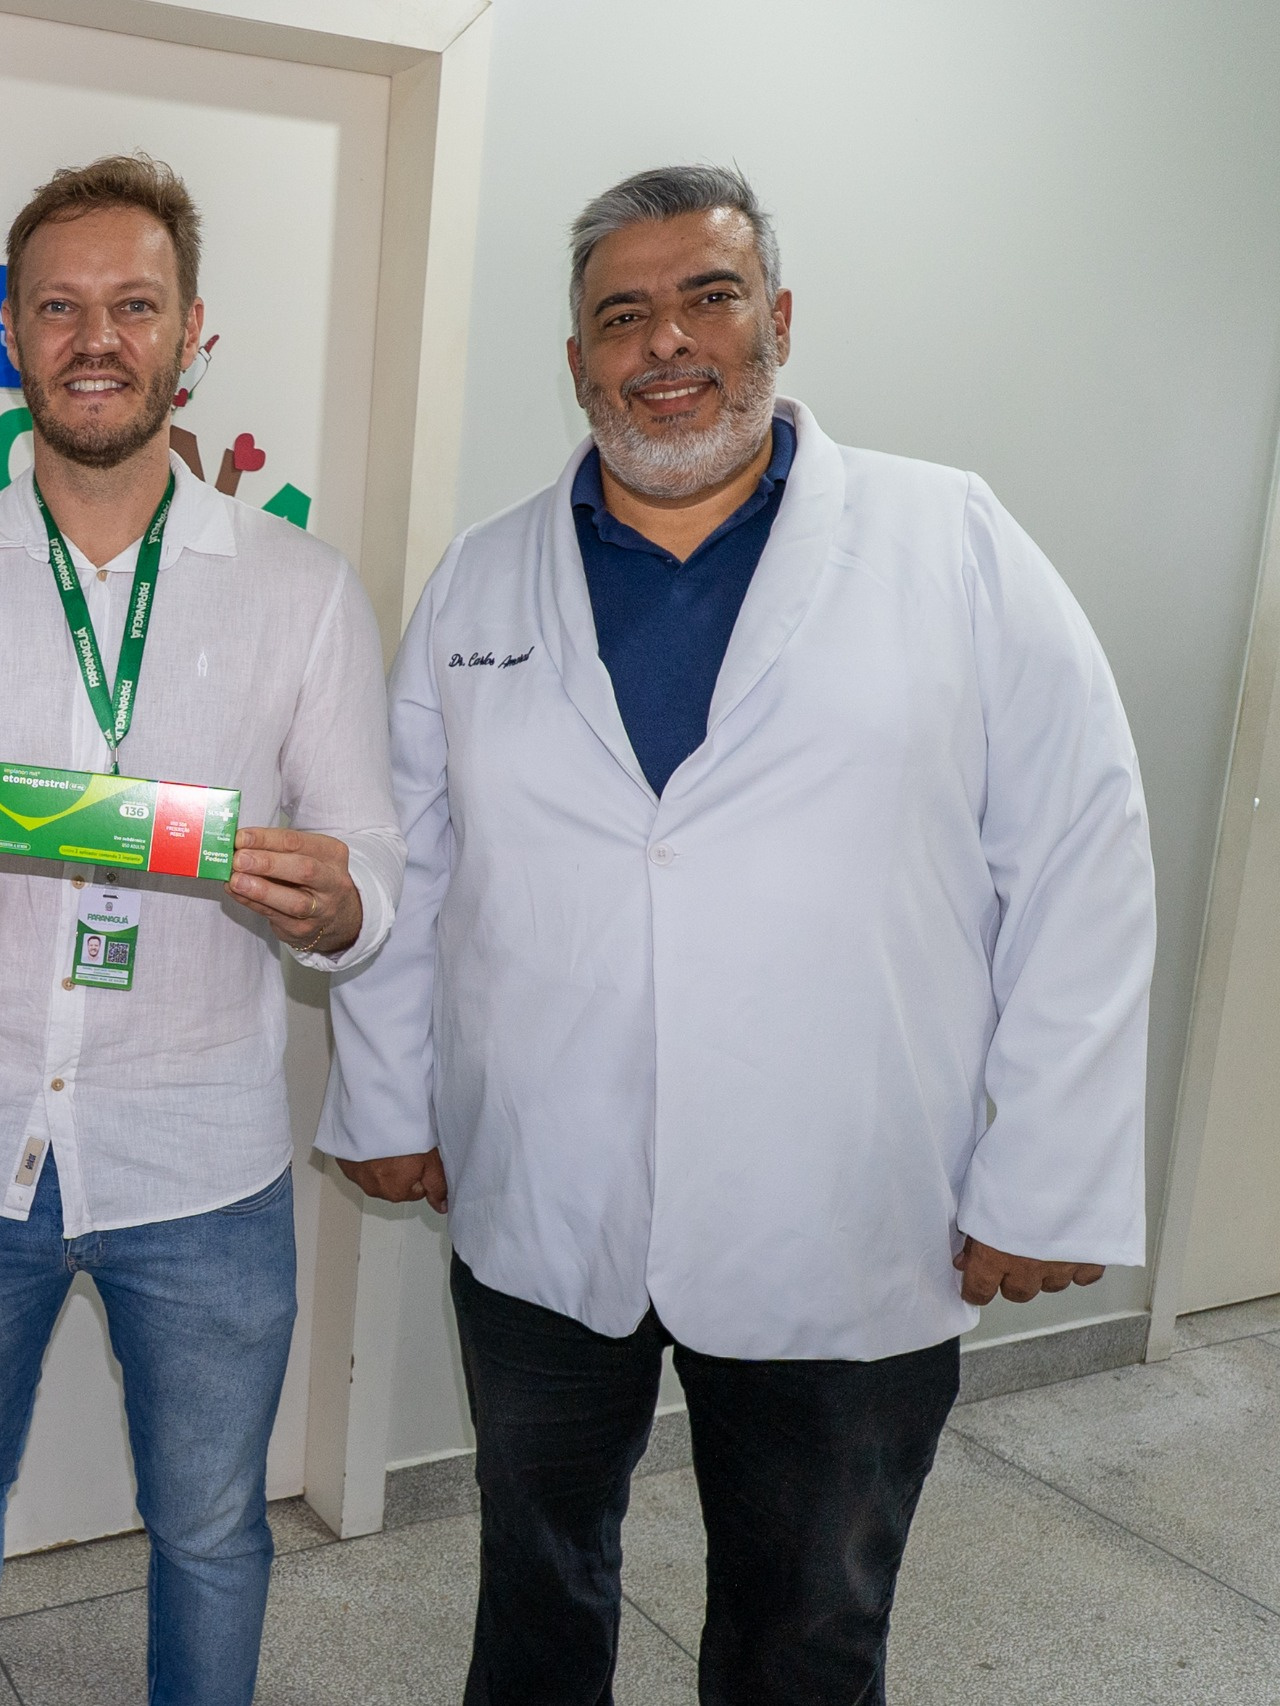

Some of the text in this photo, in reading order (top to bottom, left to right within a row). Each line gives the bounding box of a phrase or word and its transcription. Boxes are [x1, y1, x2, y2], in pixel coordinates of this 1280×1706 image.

[131, 582, 150, 639] PARANAGUÁ
[74, 627, 99, 688] PARANAGUÁ
[3, 775, 70, 789] etonogestrel
[125, 806, 144, 817] 136
[87, 913, 129, 924] PARANAGUÁ
